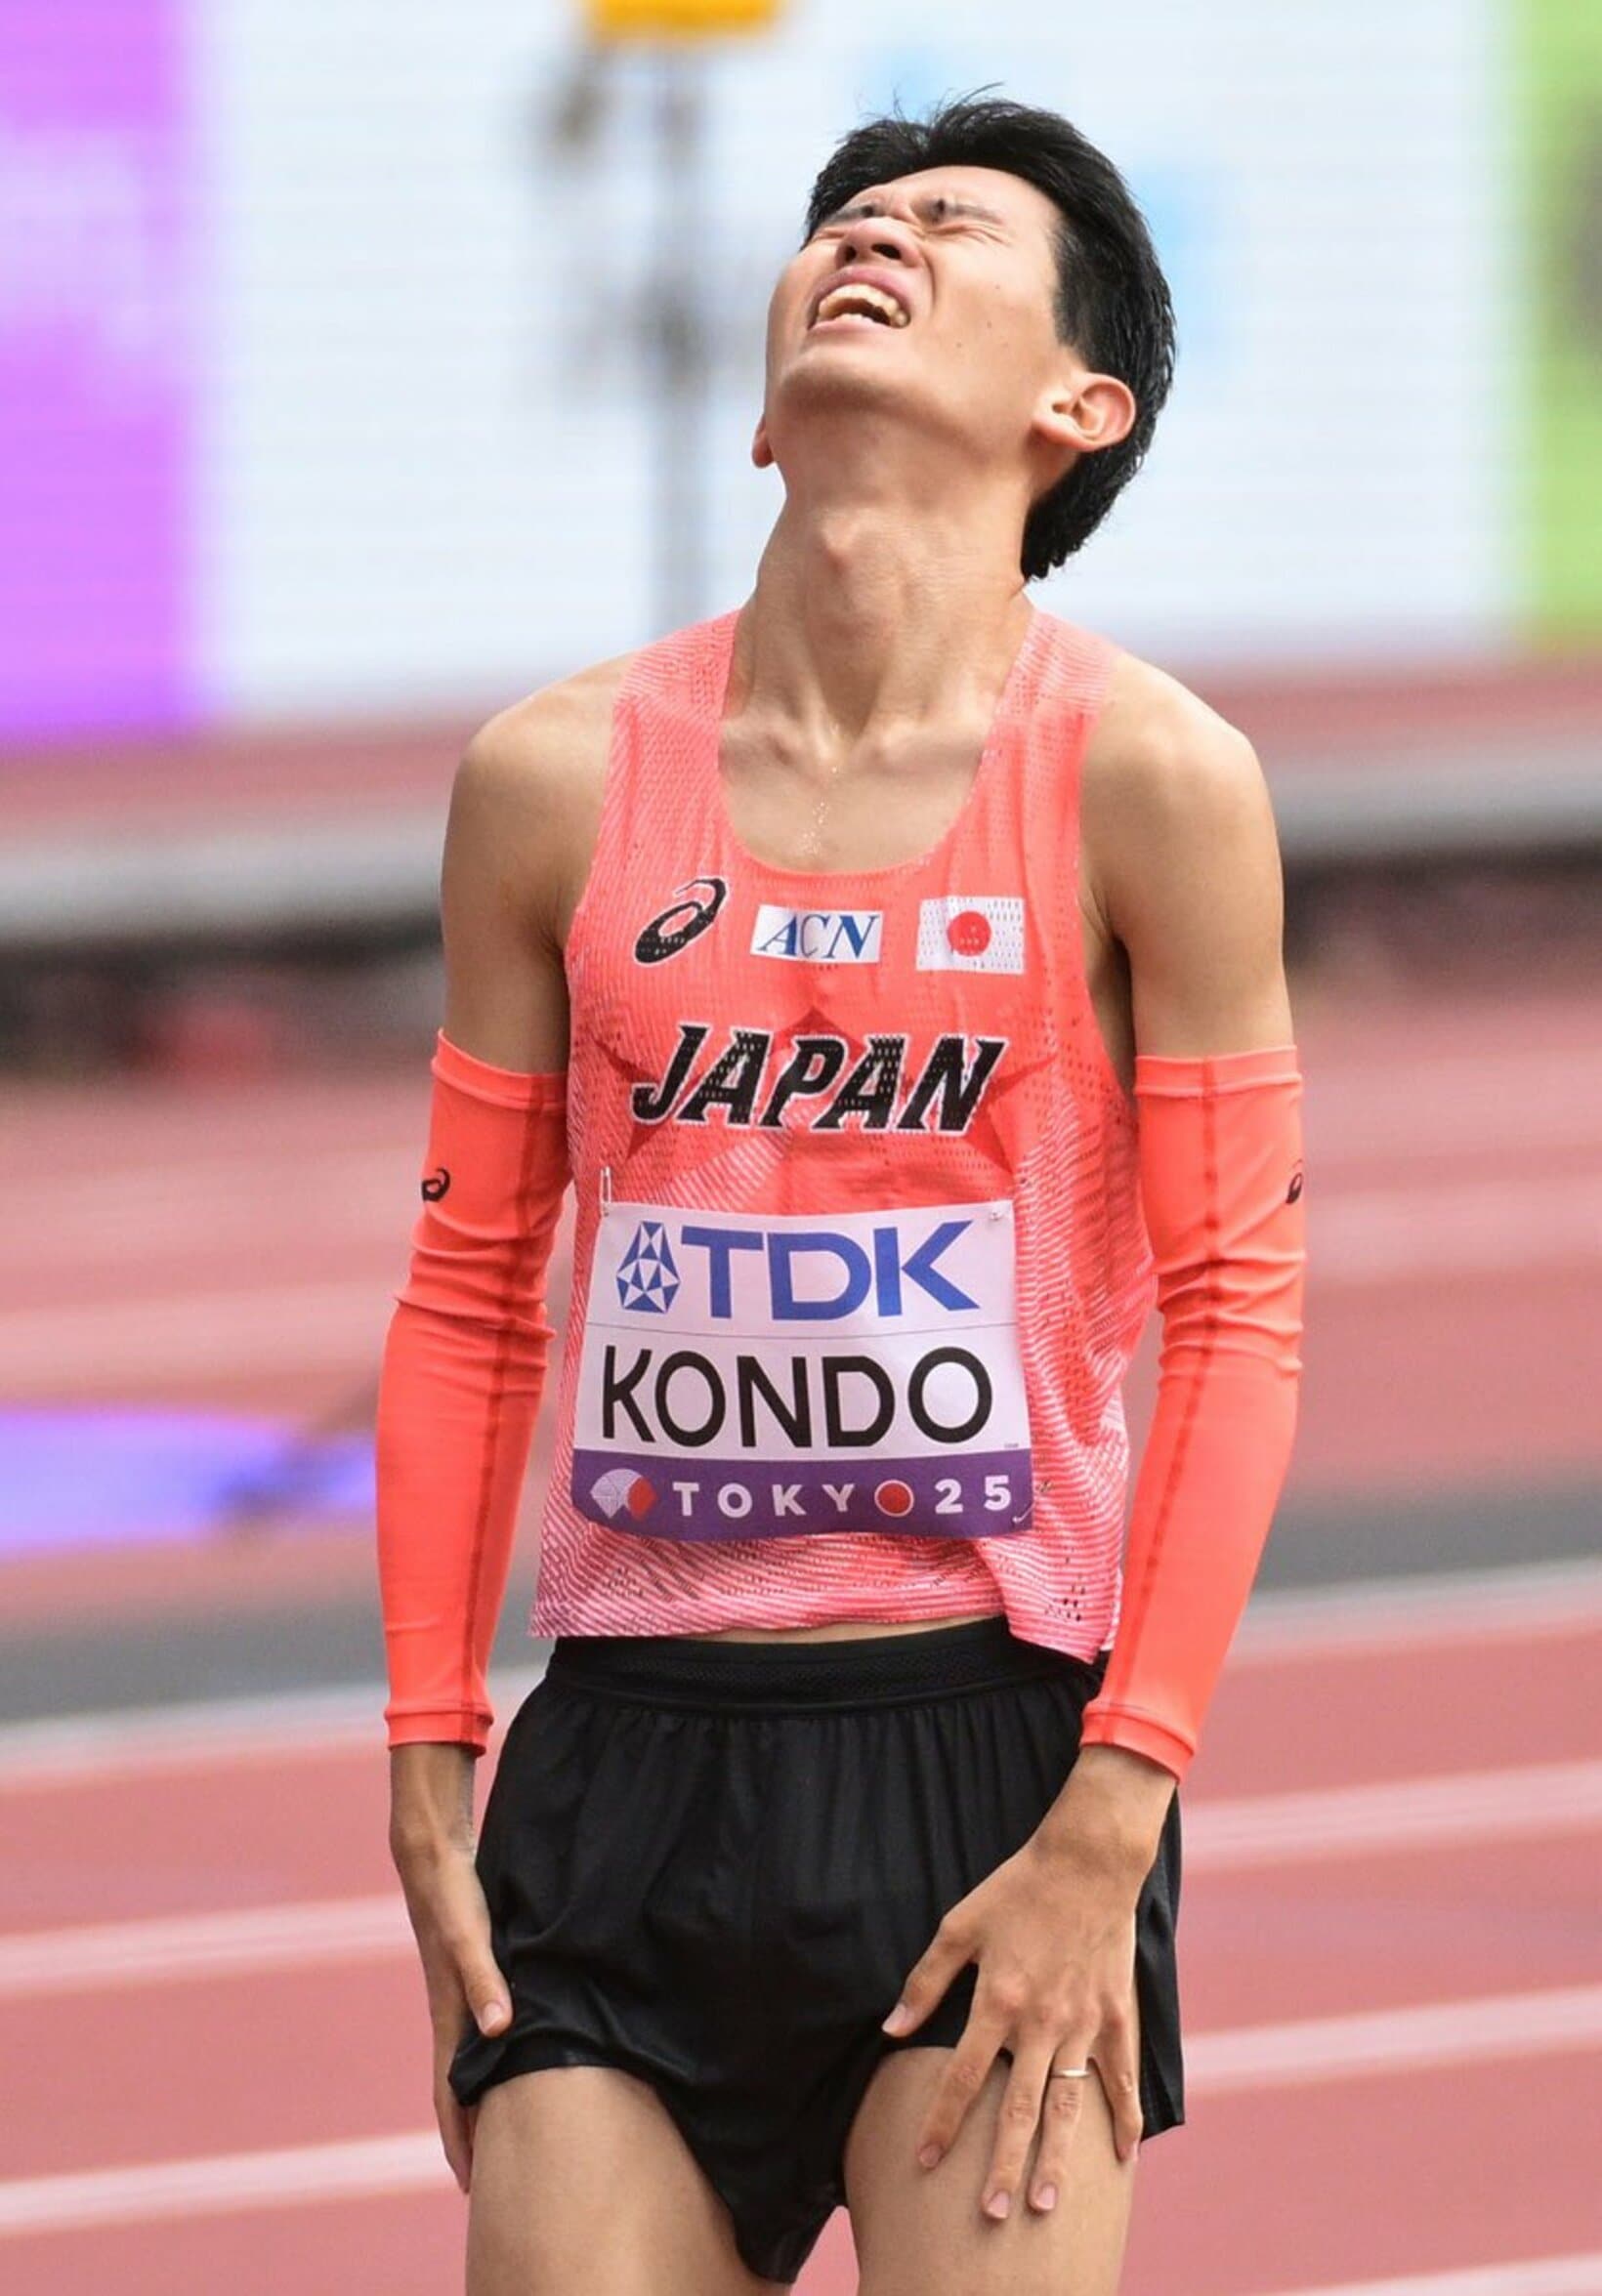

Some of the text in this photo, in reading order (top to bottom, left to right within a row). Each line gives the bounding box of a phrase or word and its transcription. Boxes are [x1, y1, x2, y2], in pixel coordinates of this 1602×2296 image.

[756, 912, 879, 959] ACN
[630, 1022, 1009, 1136] JAPAN
[682, 1220, 980, 1320] TDK
[602, 1345, 992, 1447] KONDO
